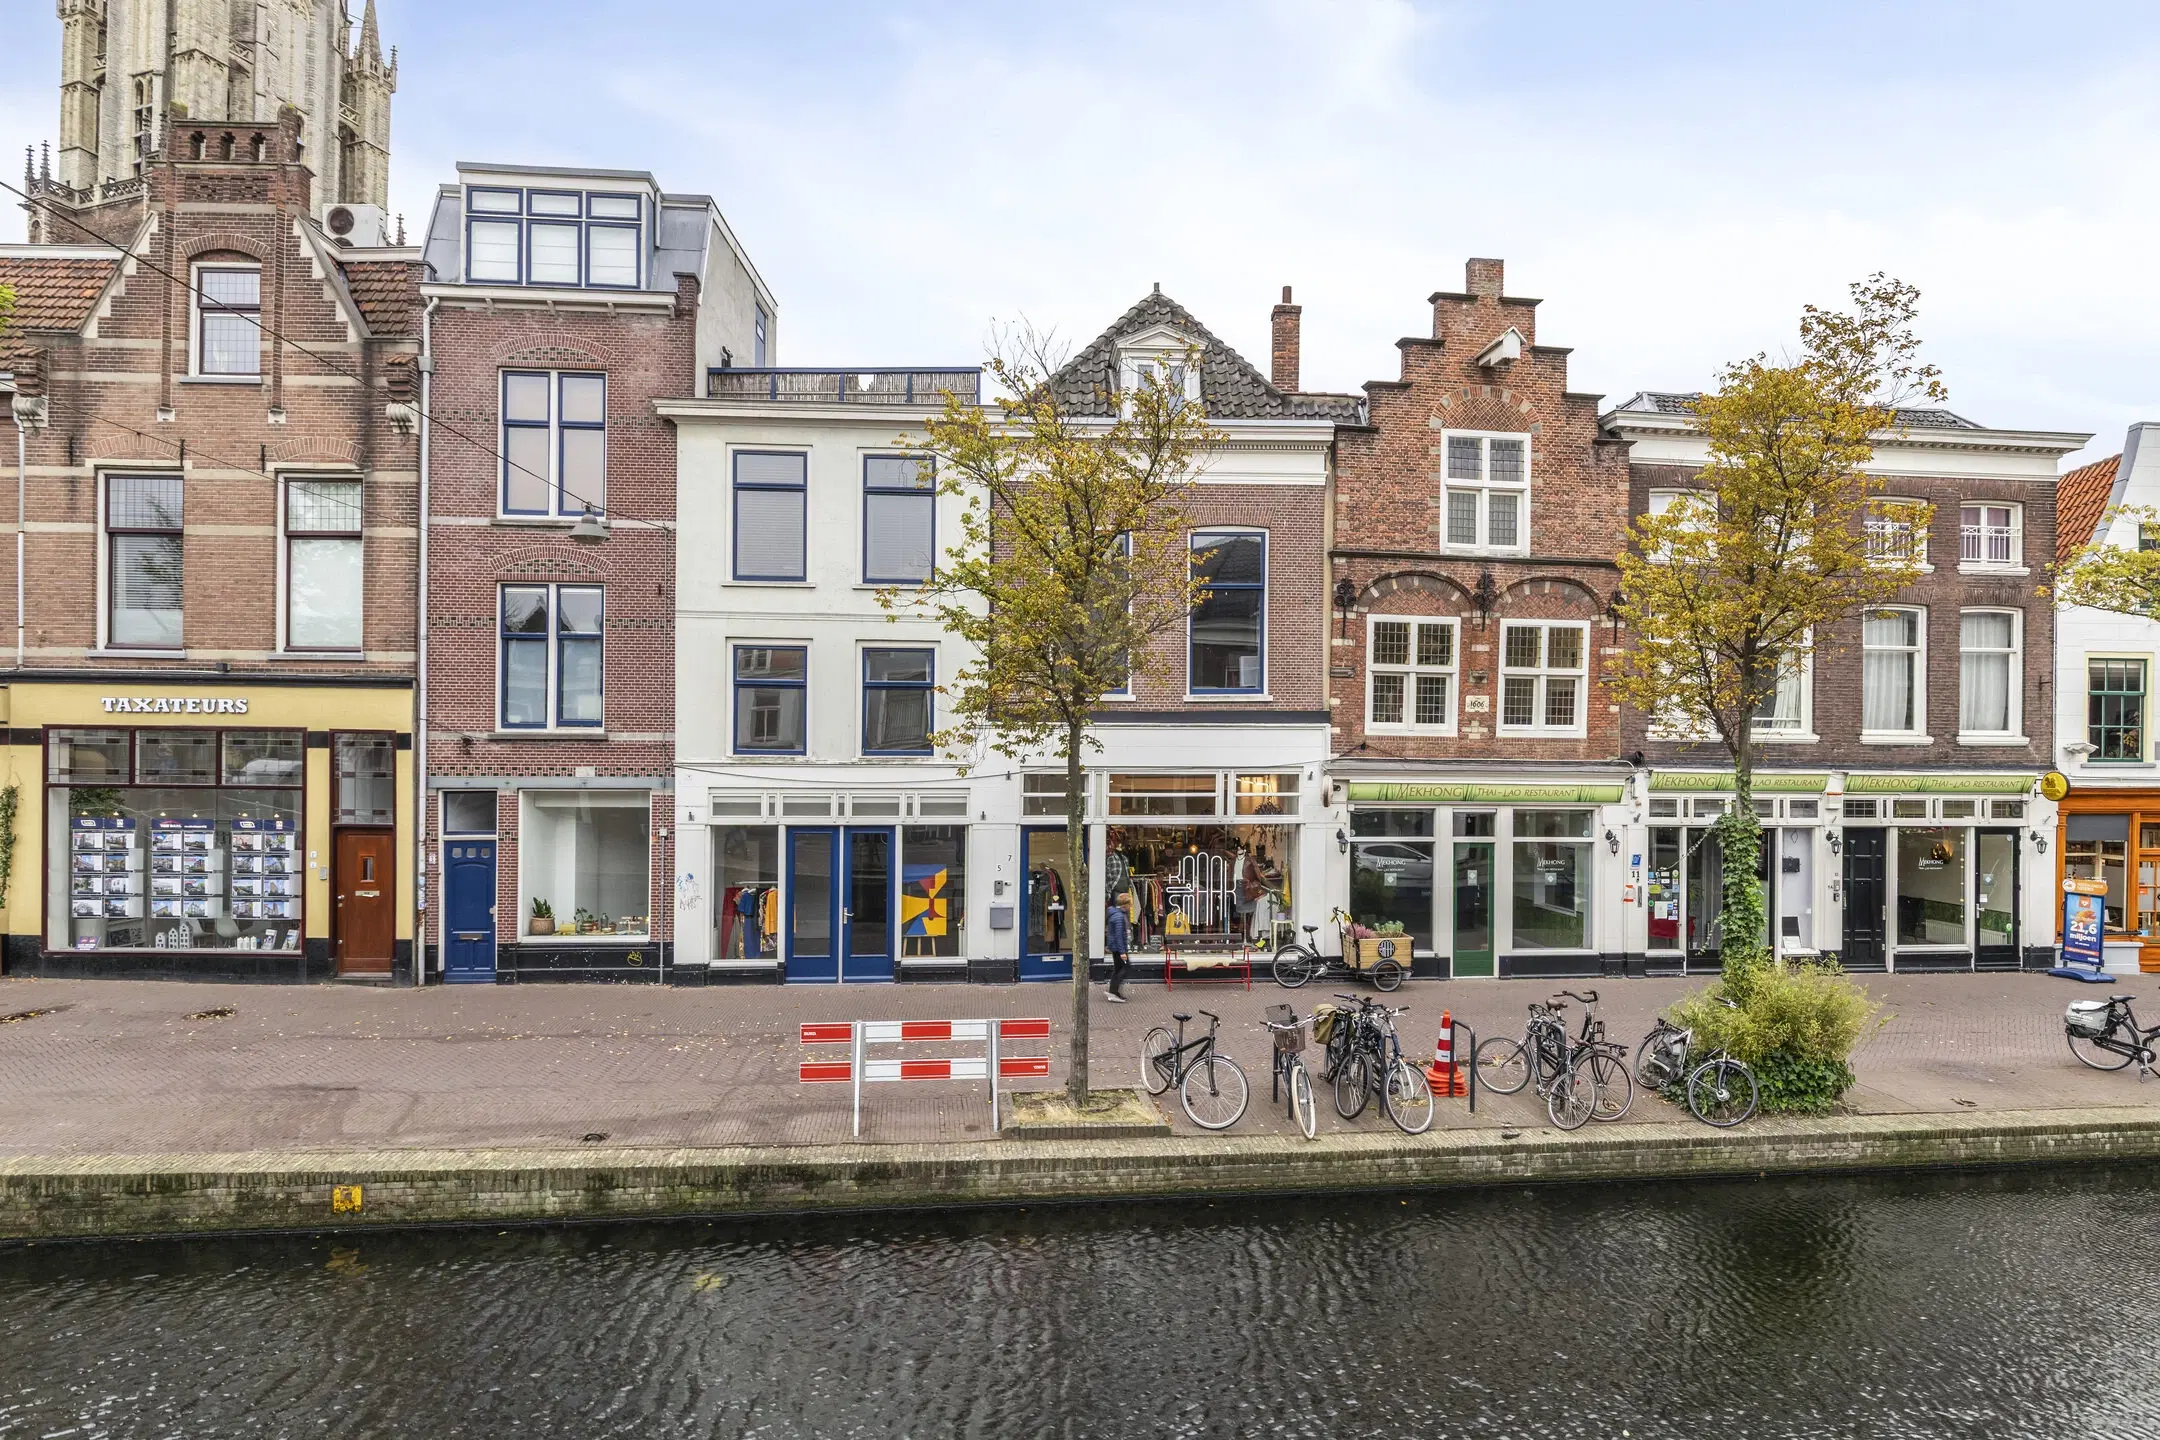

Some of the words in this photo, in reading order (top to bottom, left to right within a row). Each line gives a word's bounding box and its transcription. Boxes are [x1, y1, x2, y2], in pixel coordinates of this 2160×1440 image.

[101, 697, 249, 714] TAXATEURS
[1470, 700, 1485, 708] 1606
[1655, 773, 1717, 789] MEKHONG
[1774, 779, 1824, 787] RESTAURANT
[1859, 776, 1919, 791] MEKHONG
[1973, 780, 2021, 788] RESTAURANT
[1396, 783, 1463, 799] MEKHONG
[1524, 788, 1577, 797] RESTAURANT
[1537, 857, 1566, 867] MEKHONG
[1918, 856, 1944, 866] MEKHONG
[1631, 870, 1640, 878] 11
[2070, 920, 2097, 935] 21,6
[2069, 933, 2097, 942] miljoen
